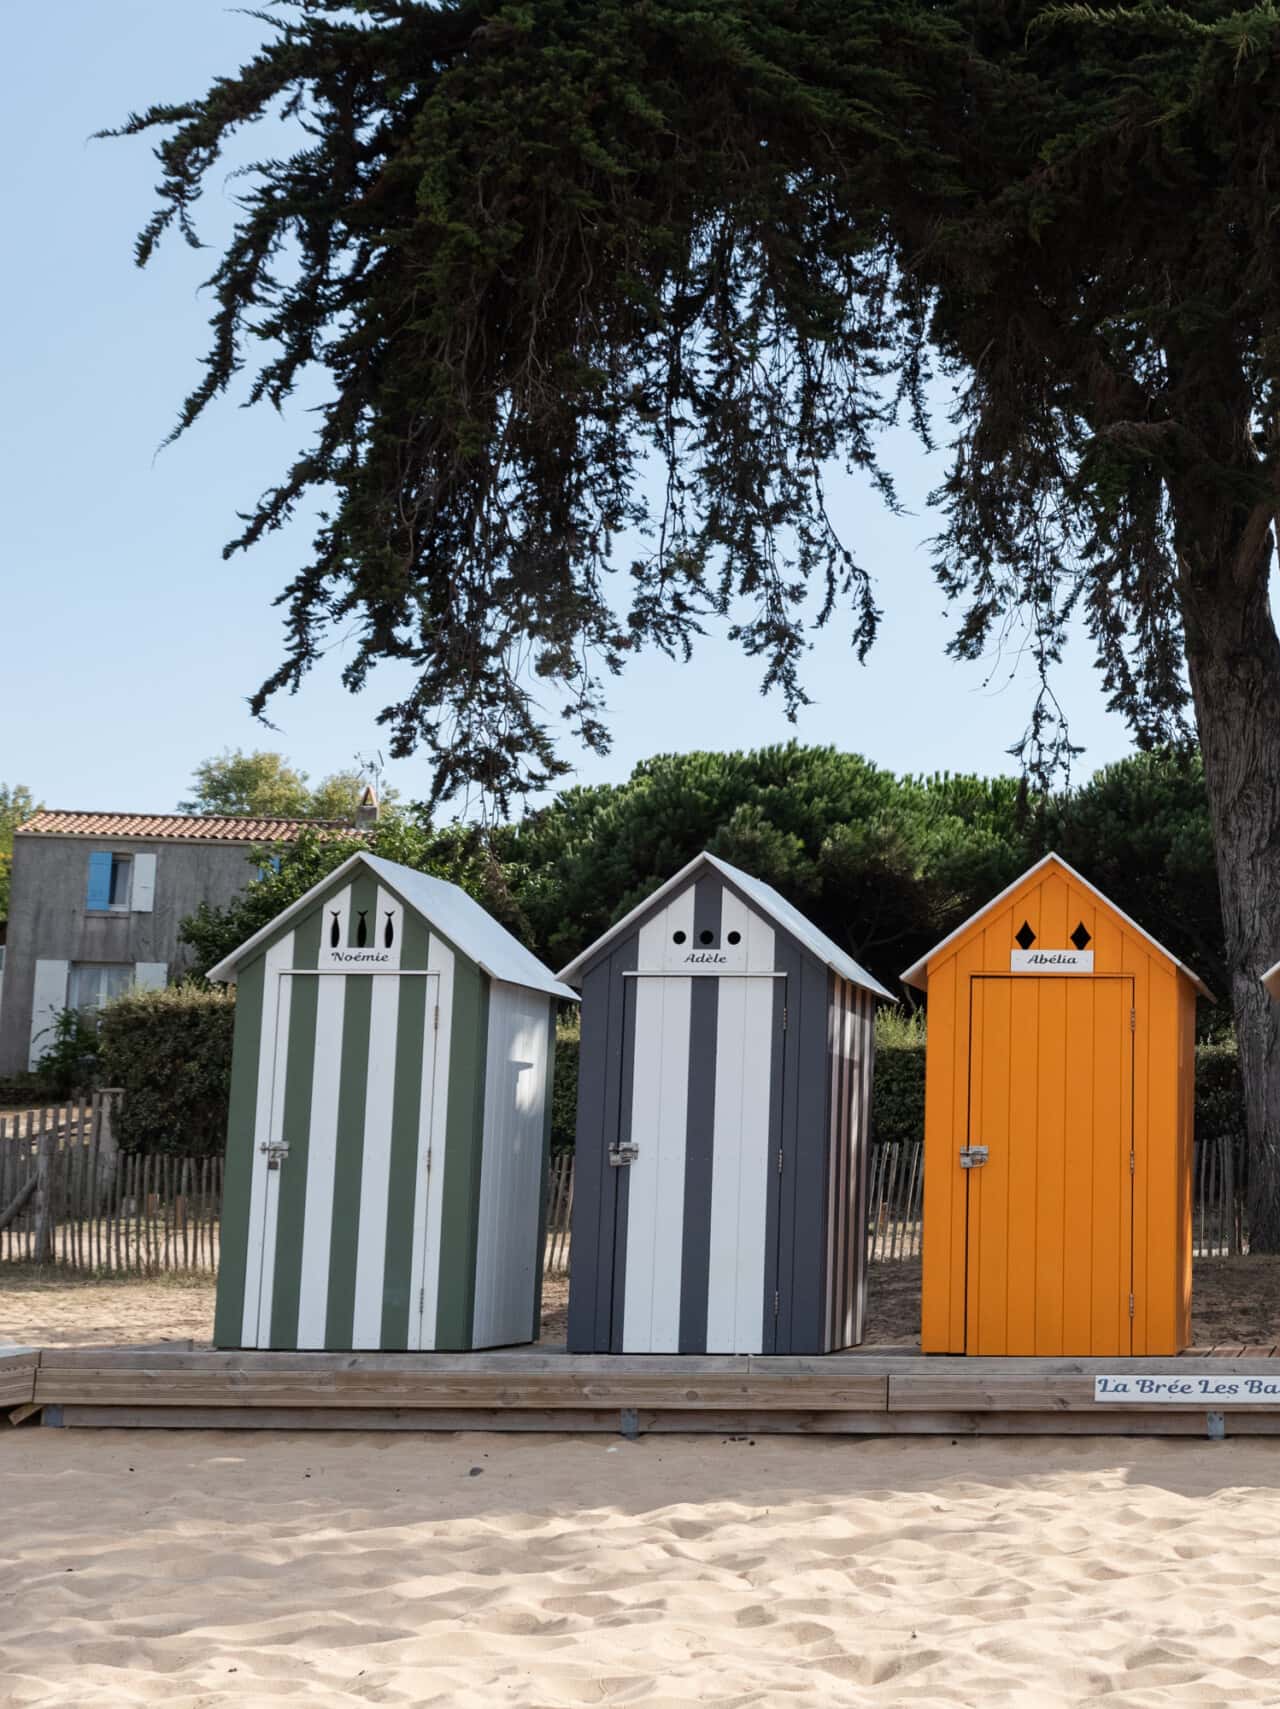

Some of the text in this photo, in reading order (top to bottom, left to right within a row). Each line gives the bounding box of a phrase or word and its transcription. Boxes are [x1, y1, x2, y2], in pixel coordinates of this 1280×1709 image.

[331, 952, 389, 962] Noémie
[685, 953, 727, 963] Adèle
[1028, 953, 1077, 964] Abélia
[1098, 1379, 1129, 1393] La
[1136, 1379, 1193, 1394] Brée
[1198, 1380, 1239, 1394] Les
